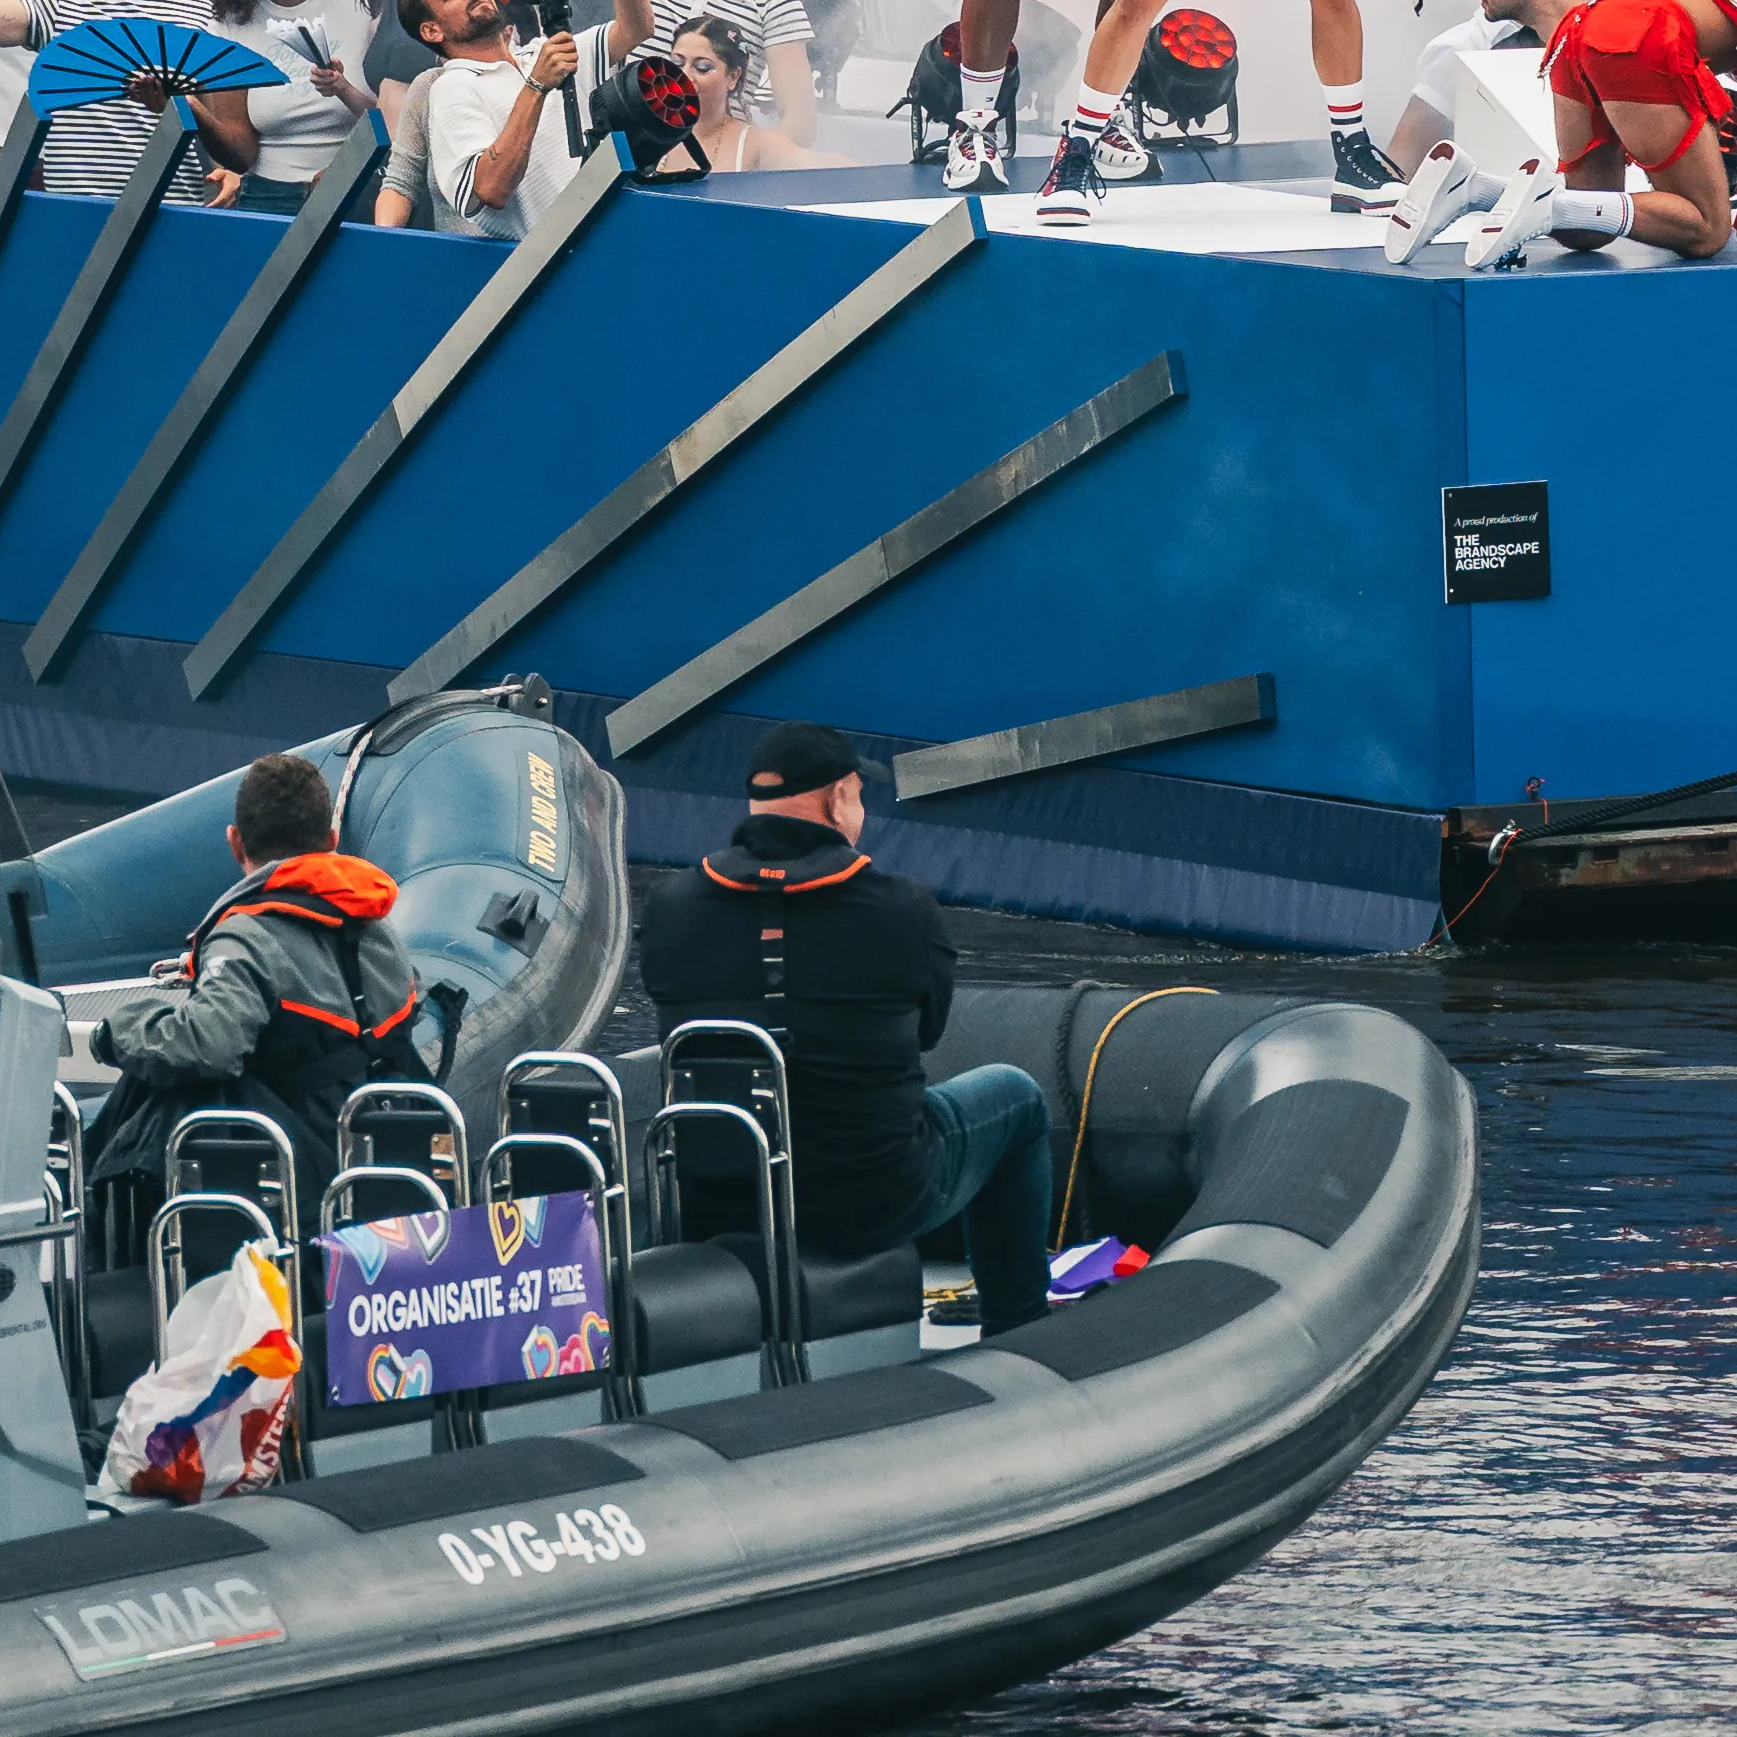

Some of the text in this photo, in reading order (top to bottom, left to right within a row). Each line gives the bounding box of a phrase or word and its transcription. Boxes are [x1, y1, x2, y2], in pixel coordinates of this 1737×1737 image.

[1453, 512, 1539, 528] A proud production of
[1454, 534, 1480, 547] THE
[1454, 542, 1539, 559] BRANDSCAPE
[1455, 557, 1507, 571] AGENCY
[527, 751, 558, 873] TWO AND CREW
[348, 1264, 585, 1338] ORGANISATIE #37 PRIDE
[438, 1503, 647, 1586] 0-YG-438
[38, 1577, 275, 1664] LOMAC
